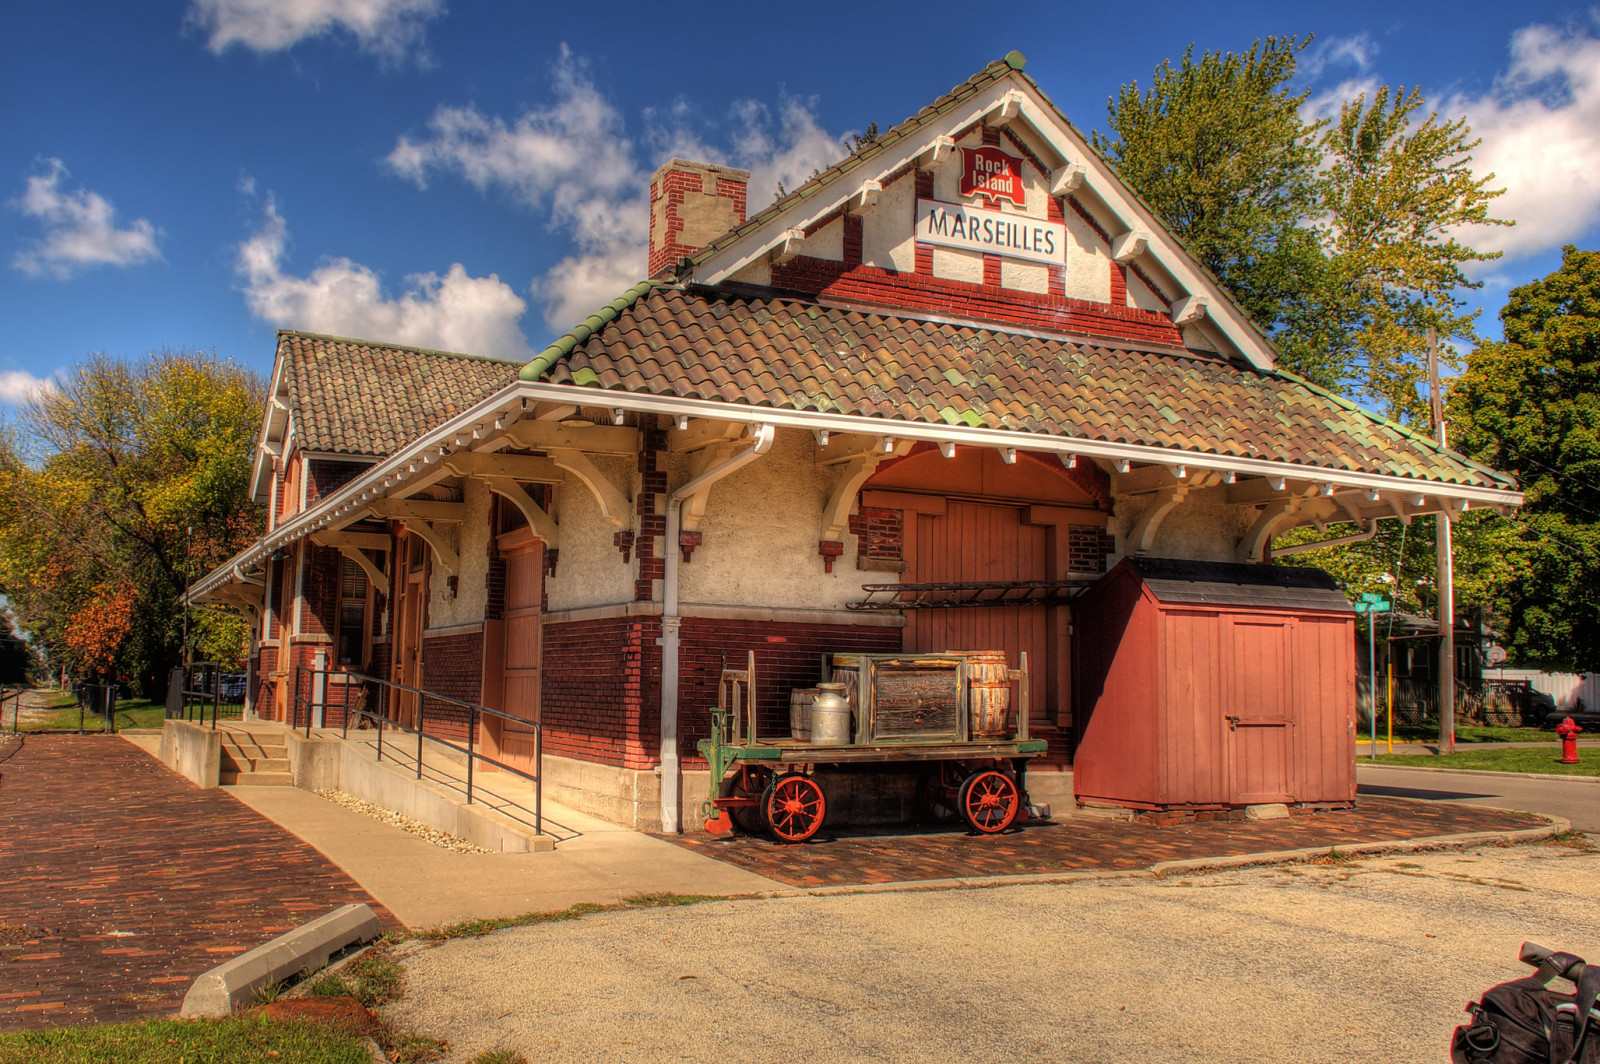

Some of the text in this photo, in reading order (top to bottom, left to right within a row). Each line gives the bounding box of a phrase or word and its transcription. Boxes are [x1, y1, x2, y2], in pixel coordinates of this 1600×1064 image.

[975, 154, 1010, 176] Rock
[972, 170, 1013, 193] Island
[928, 209, 1055, 255] MARSEILLES
